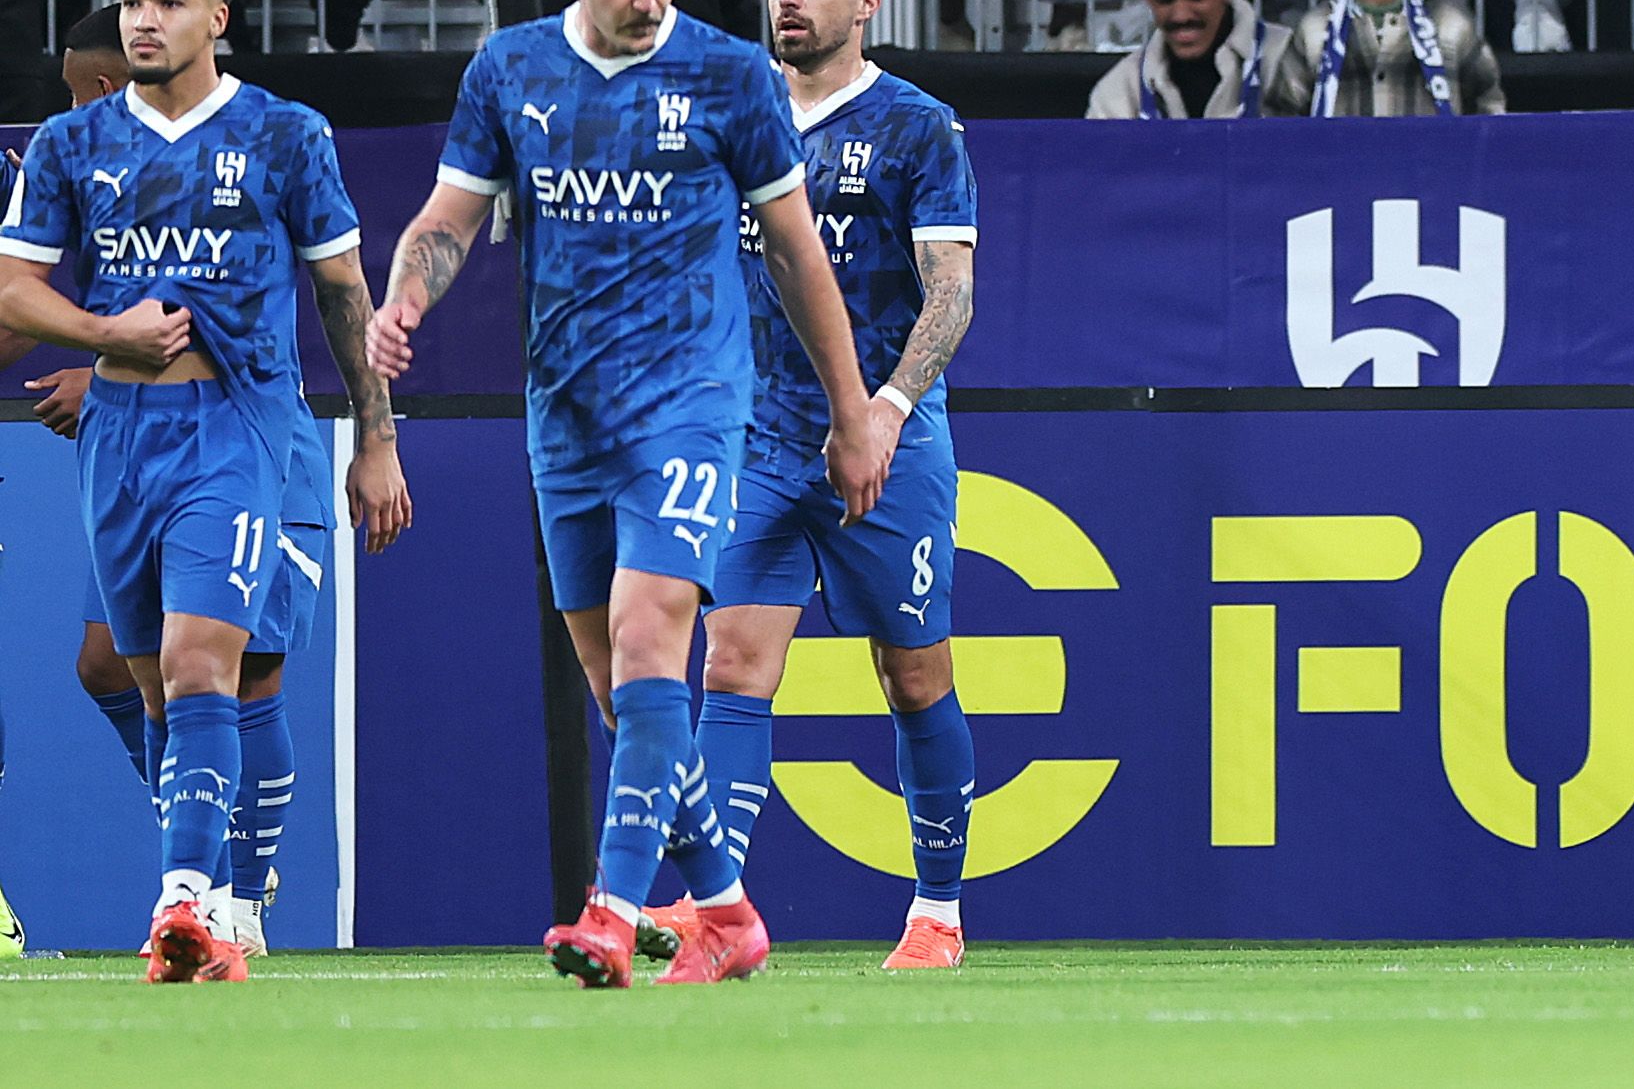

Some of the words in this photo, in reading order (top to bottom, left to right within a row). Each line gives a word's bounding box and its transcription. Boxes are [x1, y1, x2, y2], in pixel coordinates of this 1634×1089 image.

[530, 166, 674, 206] SAVVY
[603, 209, 672, 224] GROUP
[93, 226, 232, 264] SAVVY
[165, 265, 229, 280] GROUP
[658, 456, 720, 528] 22
[231, 511, 265, 574] 11
[912, 535, 934, 597] 8
[173, 789, 191, 804] AL
[928, 835, 964, 849] HILAL
